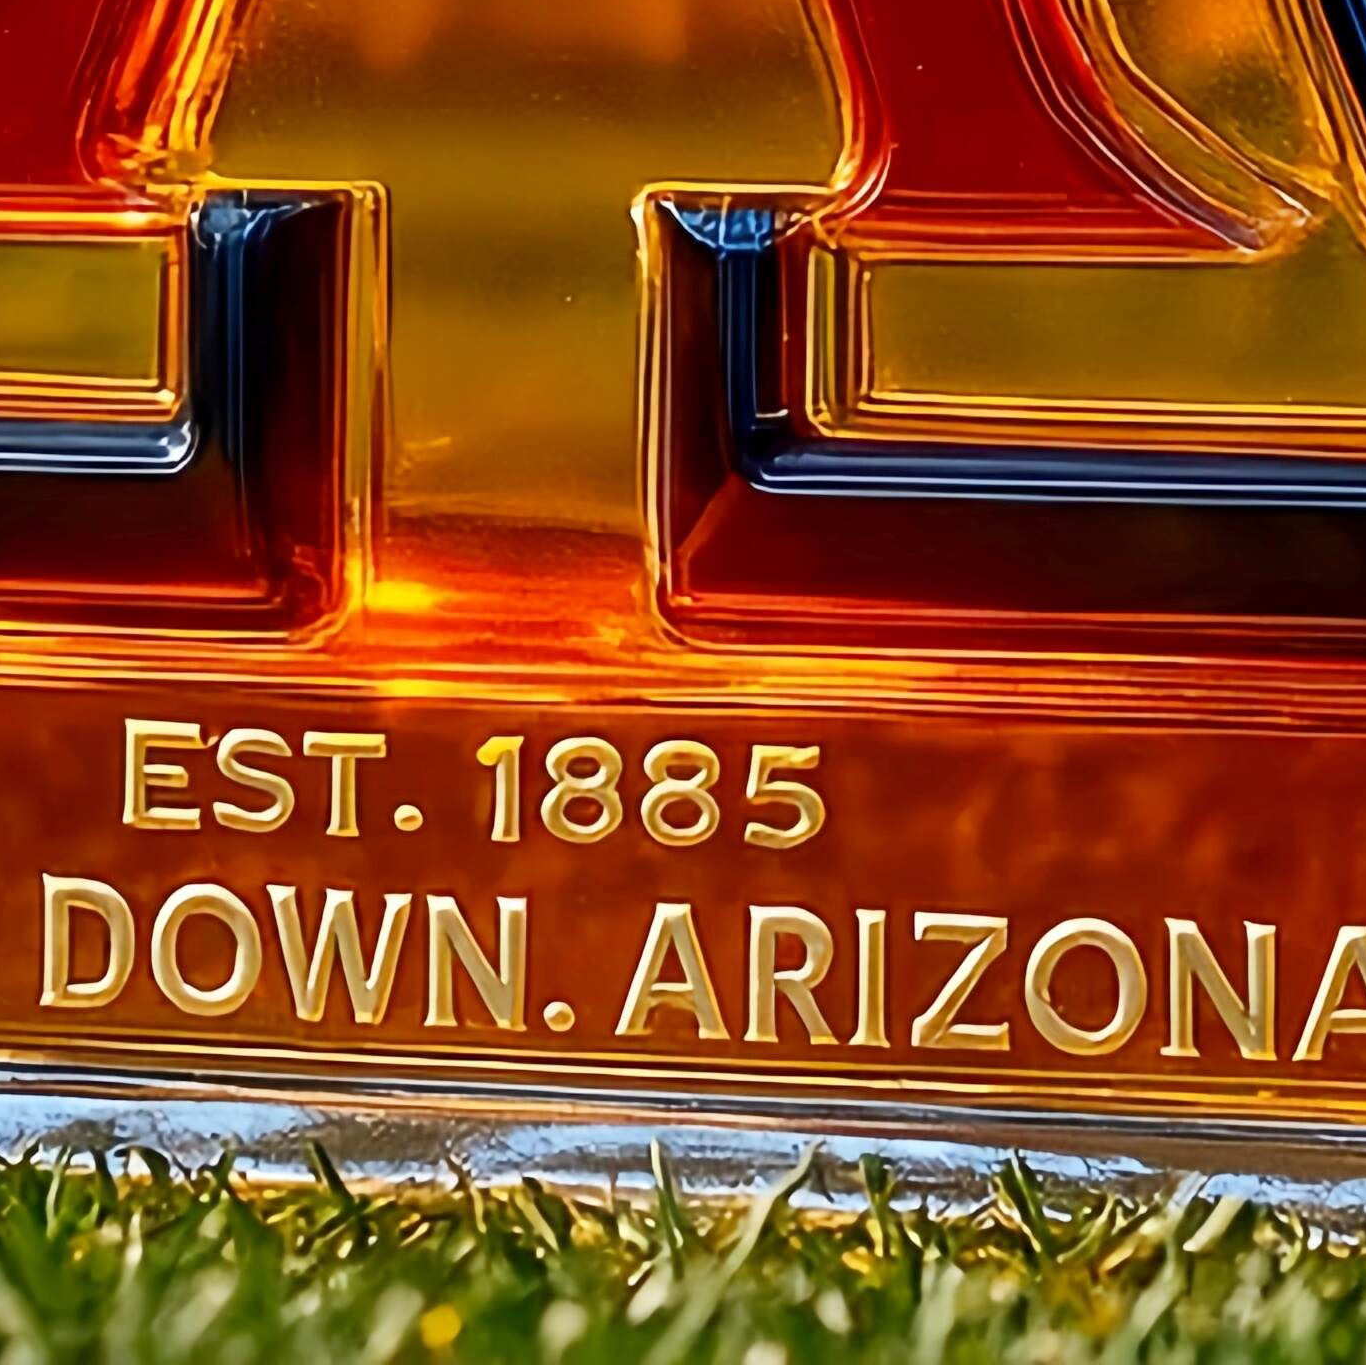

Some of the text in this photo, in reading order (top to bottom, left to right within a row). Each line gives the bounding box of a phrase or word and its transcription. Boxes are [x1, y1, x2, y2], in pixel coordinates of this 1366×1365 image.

[121, 717, 826, 849] EST. 1885
[38, 871, 577, 1033] DOWN.
